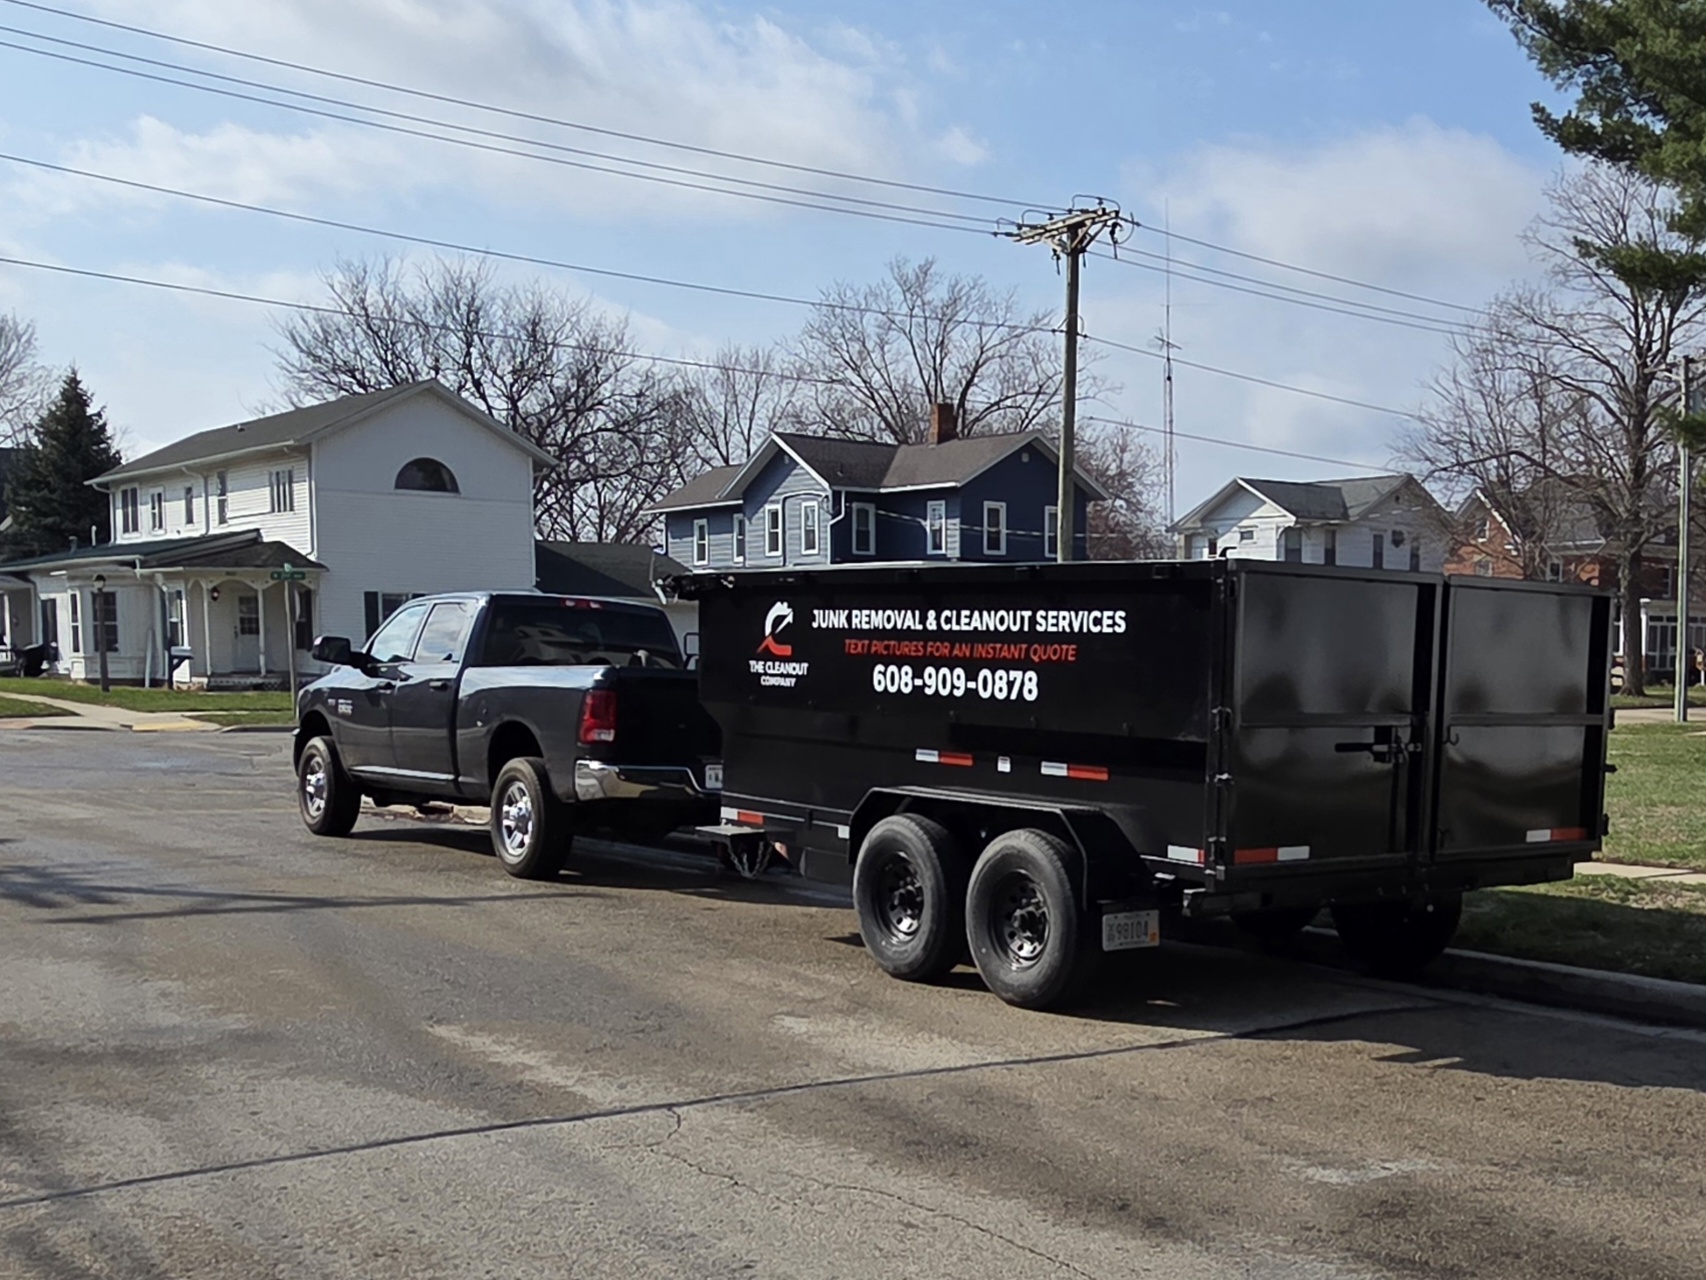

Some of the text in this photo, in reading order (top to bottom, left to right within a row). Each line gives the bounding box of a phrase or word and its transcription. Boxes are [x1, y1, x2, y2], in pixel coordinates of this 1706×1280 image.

[812, 609, 1126, 632] JUNK REMOVAL & CLEANOUT SERVICES
[845, 639, 1077, 662] TEXT PICTURES FOR AN INSTANT QUOTE
[749, 660, 809, 676] THE CLEANOUT
[760, 676, 796, 687] COMPANY
[873, 664, 1038, 701] 608-909-0878
